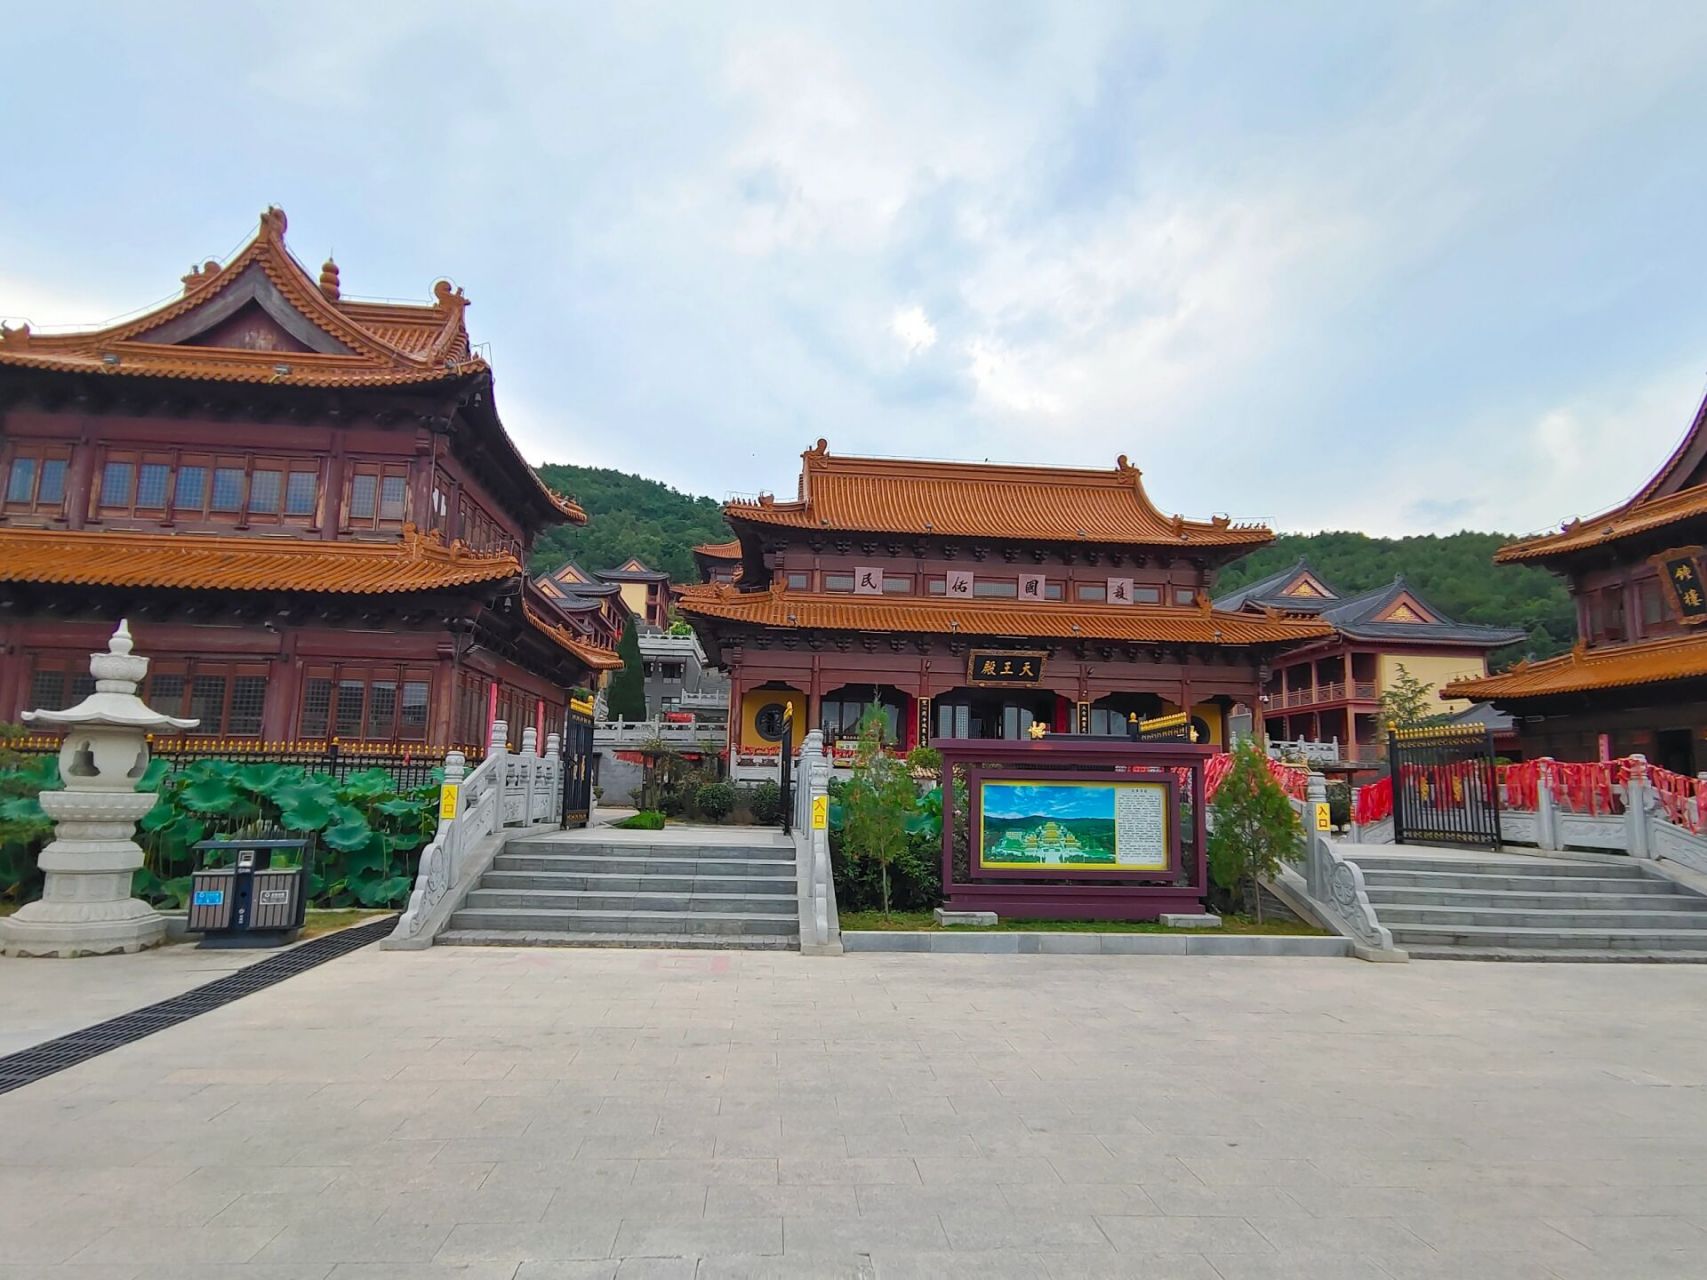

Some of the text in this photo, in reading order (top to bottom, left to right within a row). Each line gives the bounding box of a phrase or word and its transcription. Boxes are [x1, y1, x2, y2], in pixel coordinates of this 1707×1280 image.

[861, 571, 877, 589] 民
[951, 576, 968, 593] 佑
[1025, 579, 1039, 596] 國
[444, 788, 455, 813] 入口
[815, 799, 825, 824] 入口
[1318, 806, 1328, 827] 入口
